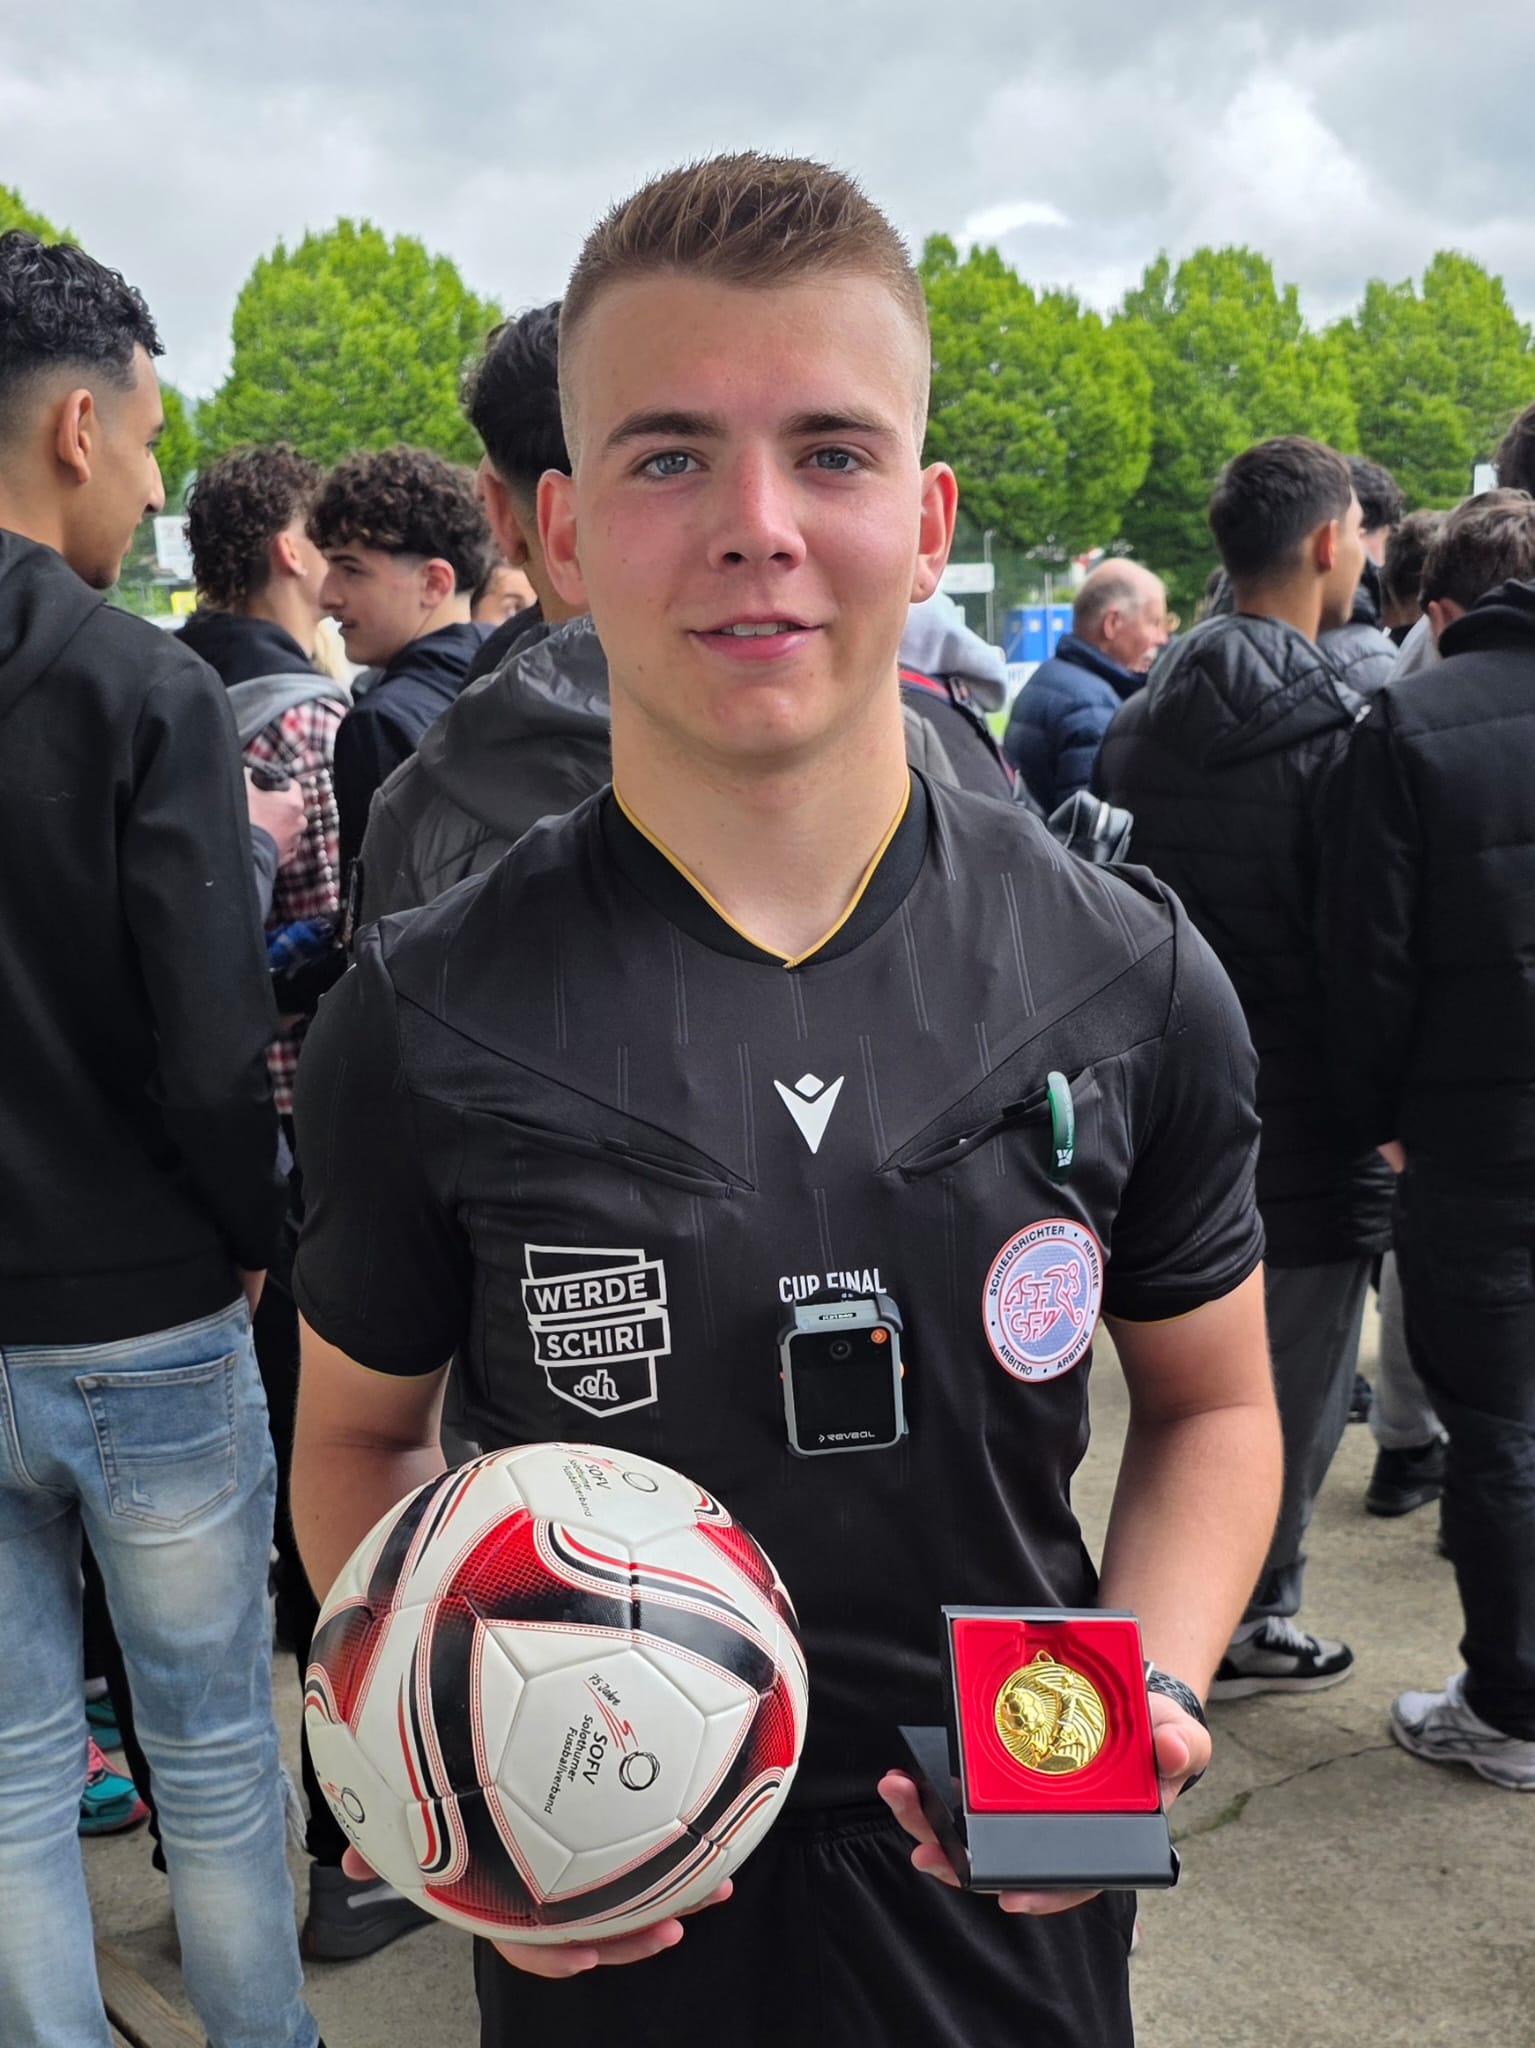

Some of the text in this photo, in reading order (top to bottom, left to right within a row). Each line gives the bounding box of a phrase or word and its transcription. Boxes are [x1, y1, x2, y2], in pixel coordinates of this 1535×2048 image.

[989, 1225, 1065, 1296] SCHIEDSRICHTER
[1082, 1239, 1099, 1289] REFEREE
[534, 1272, 648, 1313] WERDE
[778, 1268, 887, 1303] CUP FINAL
[546, 1323, 644, 1359] SCHIRI
[998, 1344, 1032, 1375] ARBITRO
[1056, 1329, 1090, 1369] ARBITRE
[573, 1369, 620, 1401] .ch
[585, 1463, 612, 1490] SOFV
[588, 1673, 621, 1706] 75 Jahre
[566, 1714, 594, 1783] Solothurner
[582, 1731, 608, 1785] SOFV
[544, 1726, 578, 1814] Fussballverband
